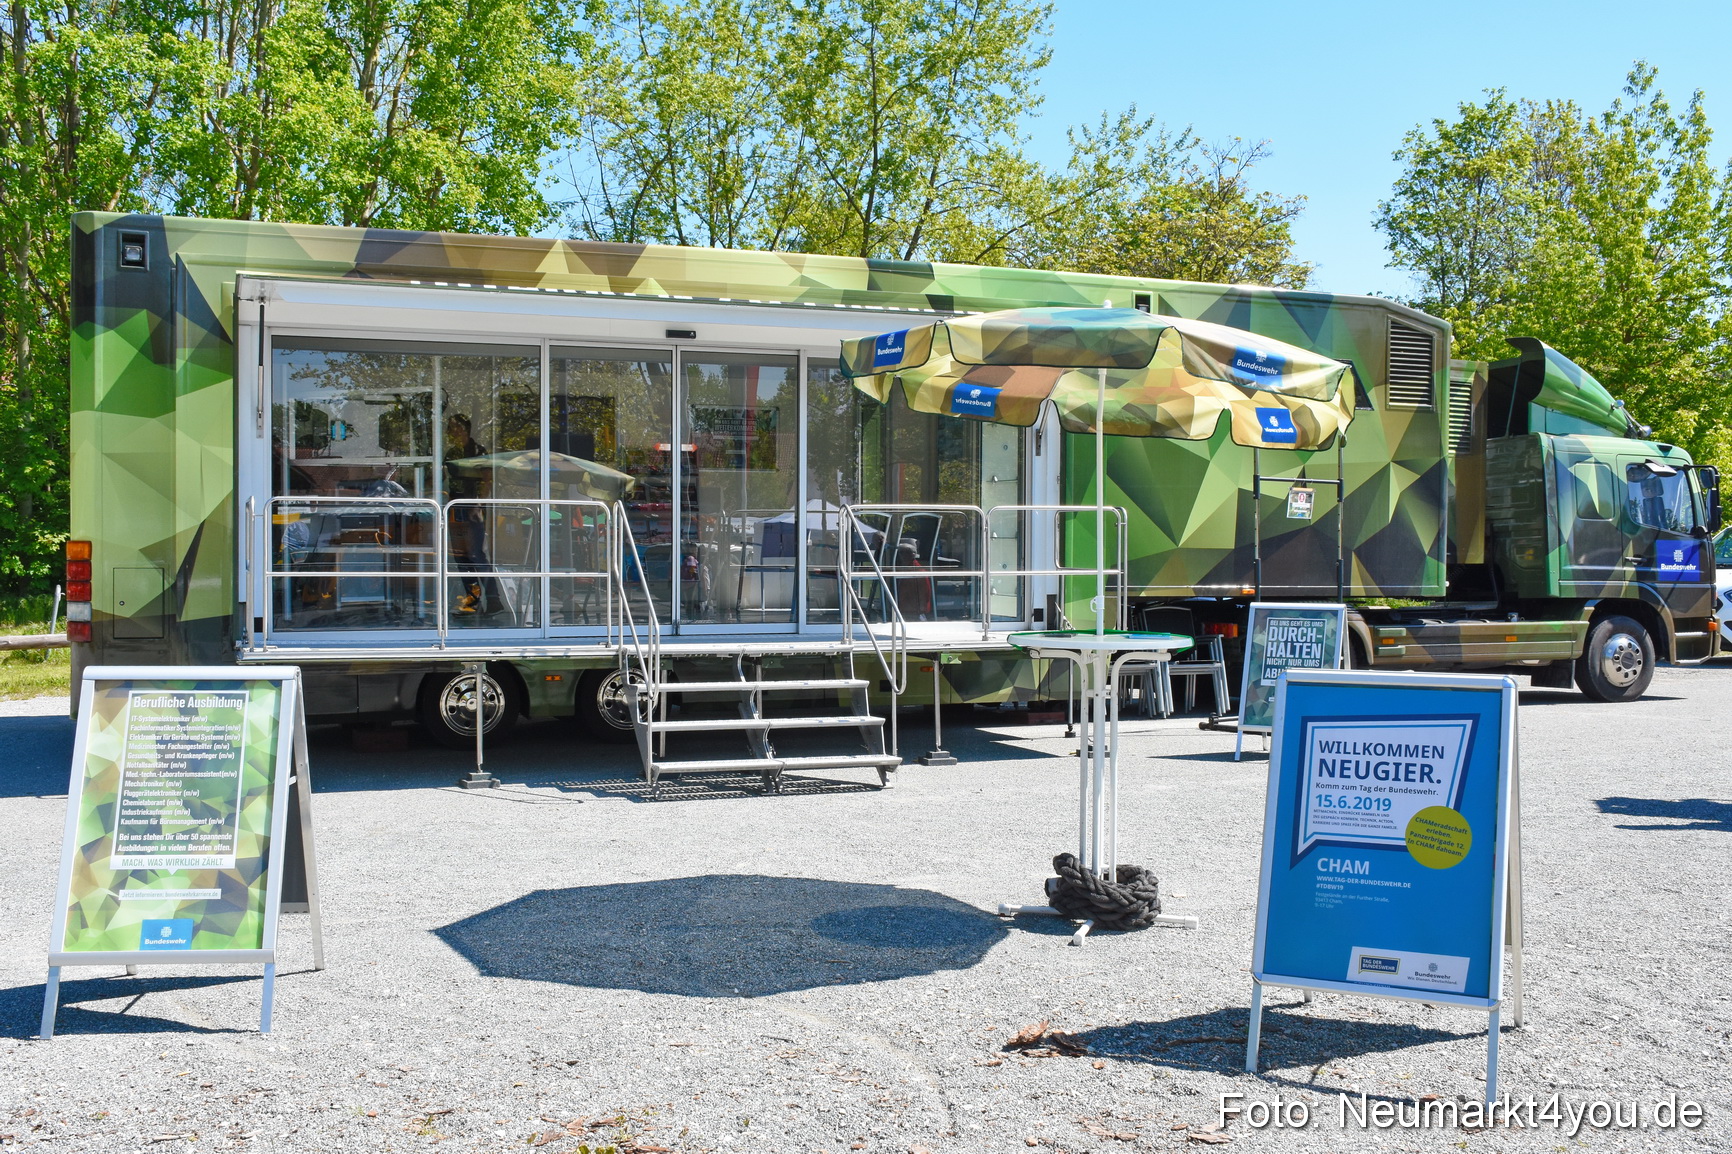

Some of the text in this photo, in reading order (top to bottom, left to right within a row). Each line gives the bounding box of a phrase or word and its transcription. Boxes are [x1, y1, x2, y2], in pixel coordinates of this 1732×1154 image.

[878, 347, 902, 355] Bundeswehr
[1237, 359, 1279, 375] Bundeswehr
[1268, 626, 1322, 642] DURCH-
[1267, 642, 1321, 658] HALTEN
[134, 697, 243, 710] Berufliche Ausbildung
[1319, 740, 1445, 759] WILLKOMMEN
[1318, 758, 1442, 784] NEUGIER.
[1359, 784, 1372, 793] Tag
[1389, 787, 1439, 796] Bundeswehr.
[1316, 794, 1392, 811] 15.6.2019
[1415, 817, 1468, 834] CHAMeradschaft
[1426, 828, 1451, 838] erleben.
[200, 833, 232, 841] spannende
[1410, 831, 1454, 847] Panzerbrigade
[118, 844, 158, 853] Ausbildungen
[1416, 840, 1434, 849] CHAM
[1436, 846, 1463, 857] dahoam.
[148, 858, 163, 866] WAS
[166, 858, 200, 866] WIRKLICH
[202, 857, 224, 866] ZÄHLT.
[1317, 858, 1370, 875] CHAM
[1316, 876, 1411, 888] WWW.TAG-DER-BUNDESWEHR.DE
[1415, 971, 1451, 980] Bundeswehr
